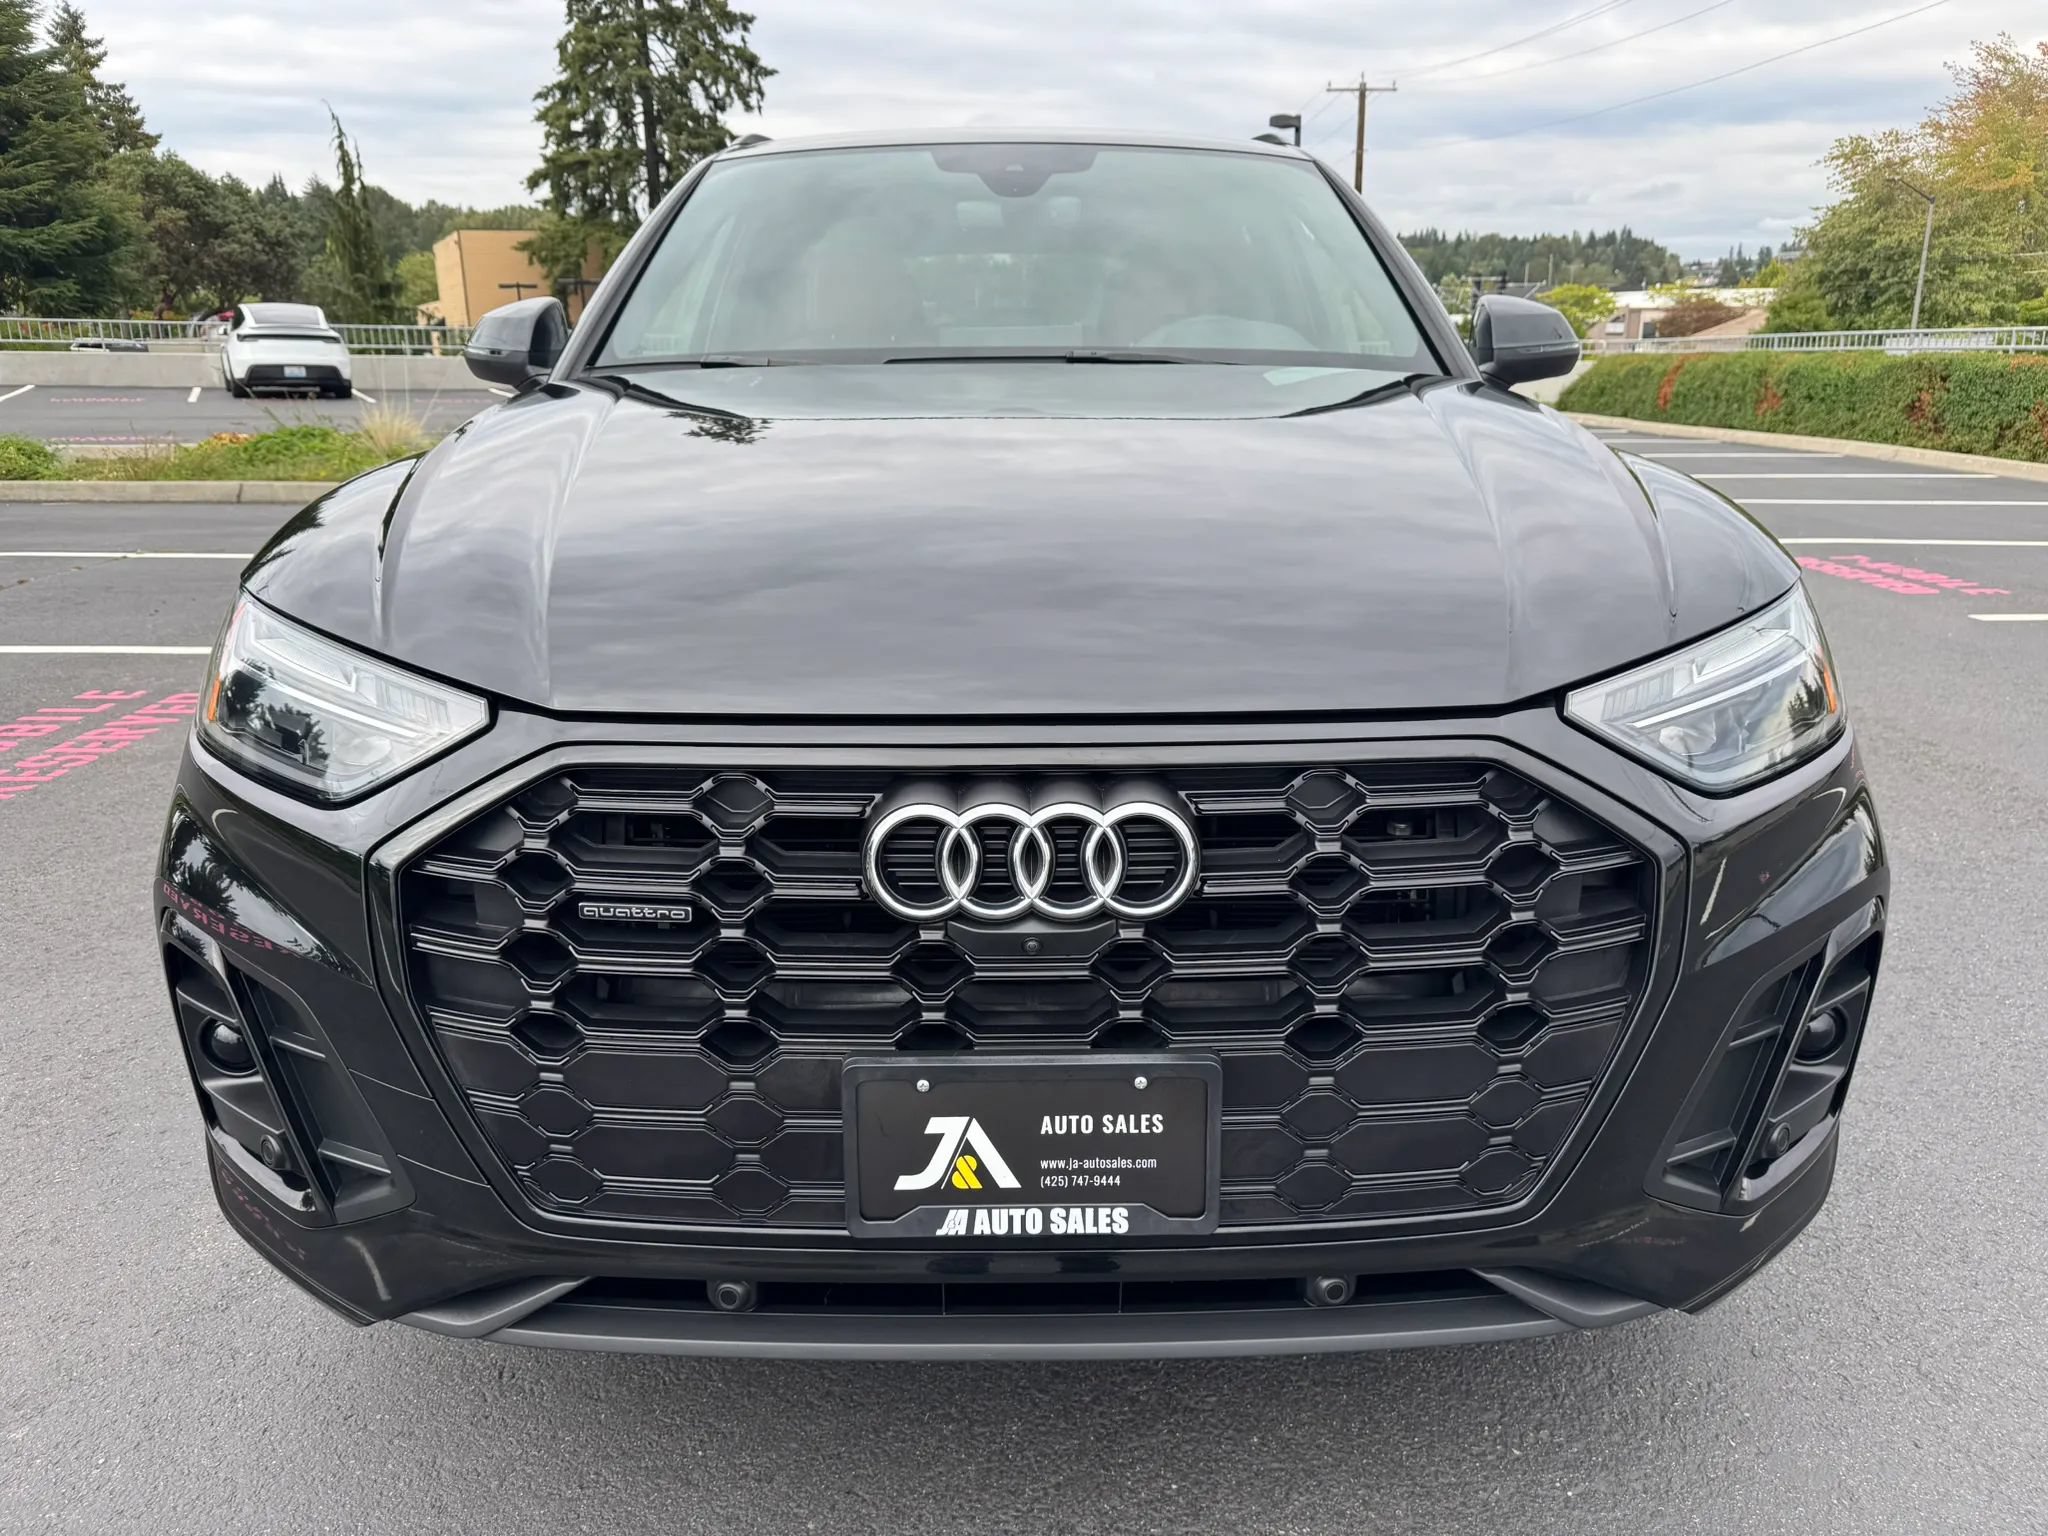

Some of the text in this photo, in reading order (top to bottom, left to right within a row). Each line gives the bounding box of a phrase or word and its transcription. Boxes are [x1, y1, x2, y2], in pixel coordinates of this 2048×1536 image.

[583, 907, 686, 919] quattro
[1040, 1113, 1164, 1135] AUTO SALES
[1040, 1156, 1157, 1171] www.ja-autosales.com
[1040, 1174, 1121, 1188] (425) 747-9444
[973, 1208, 1043, 1236] AUTO
[1050, 1207, 1130, 1235] SALES
